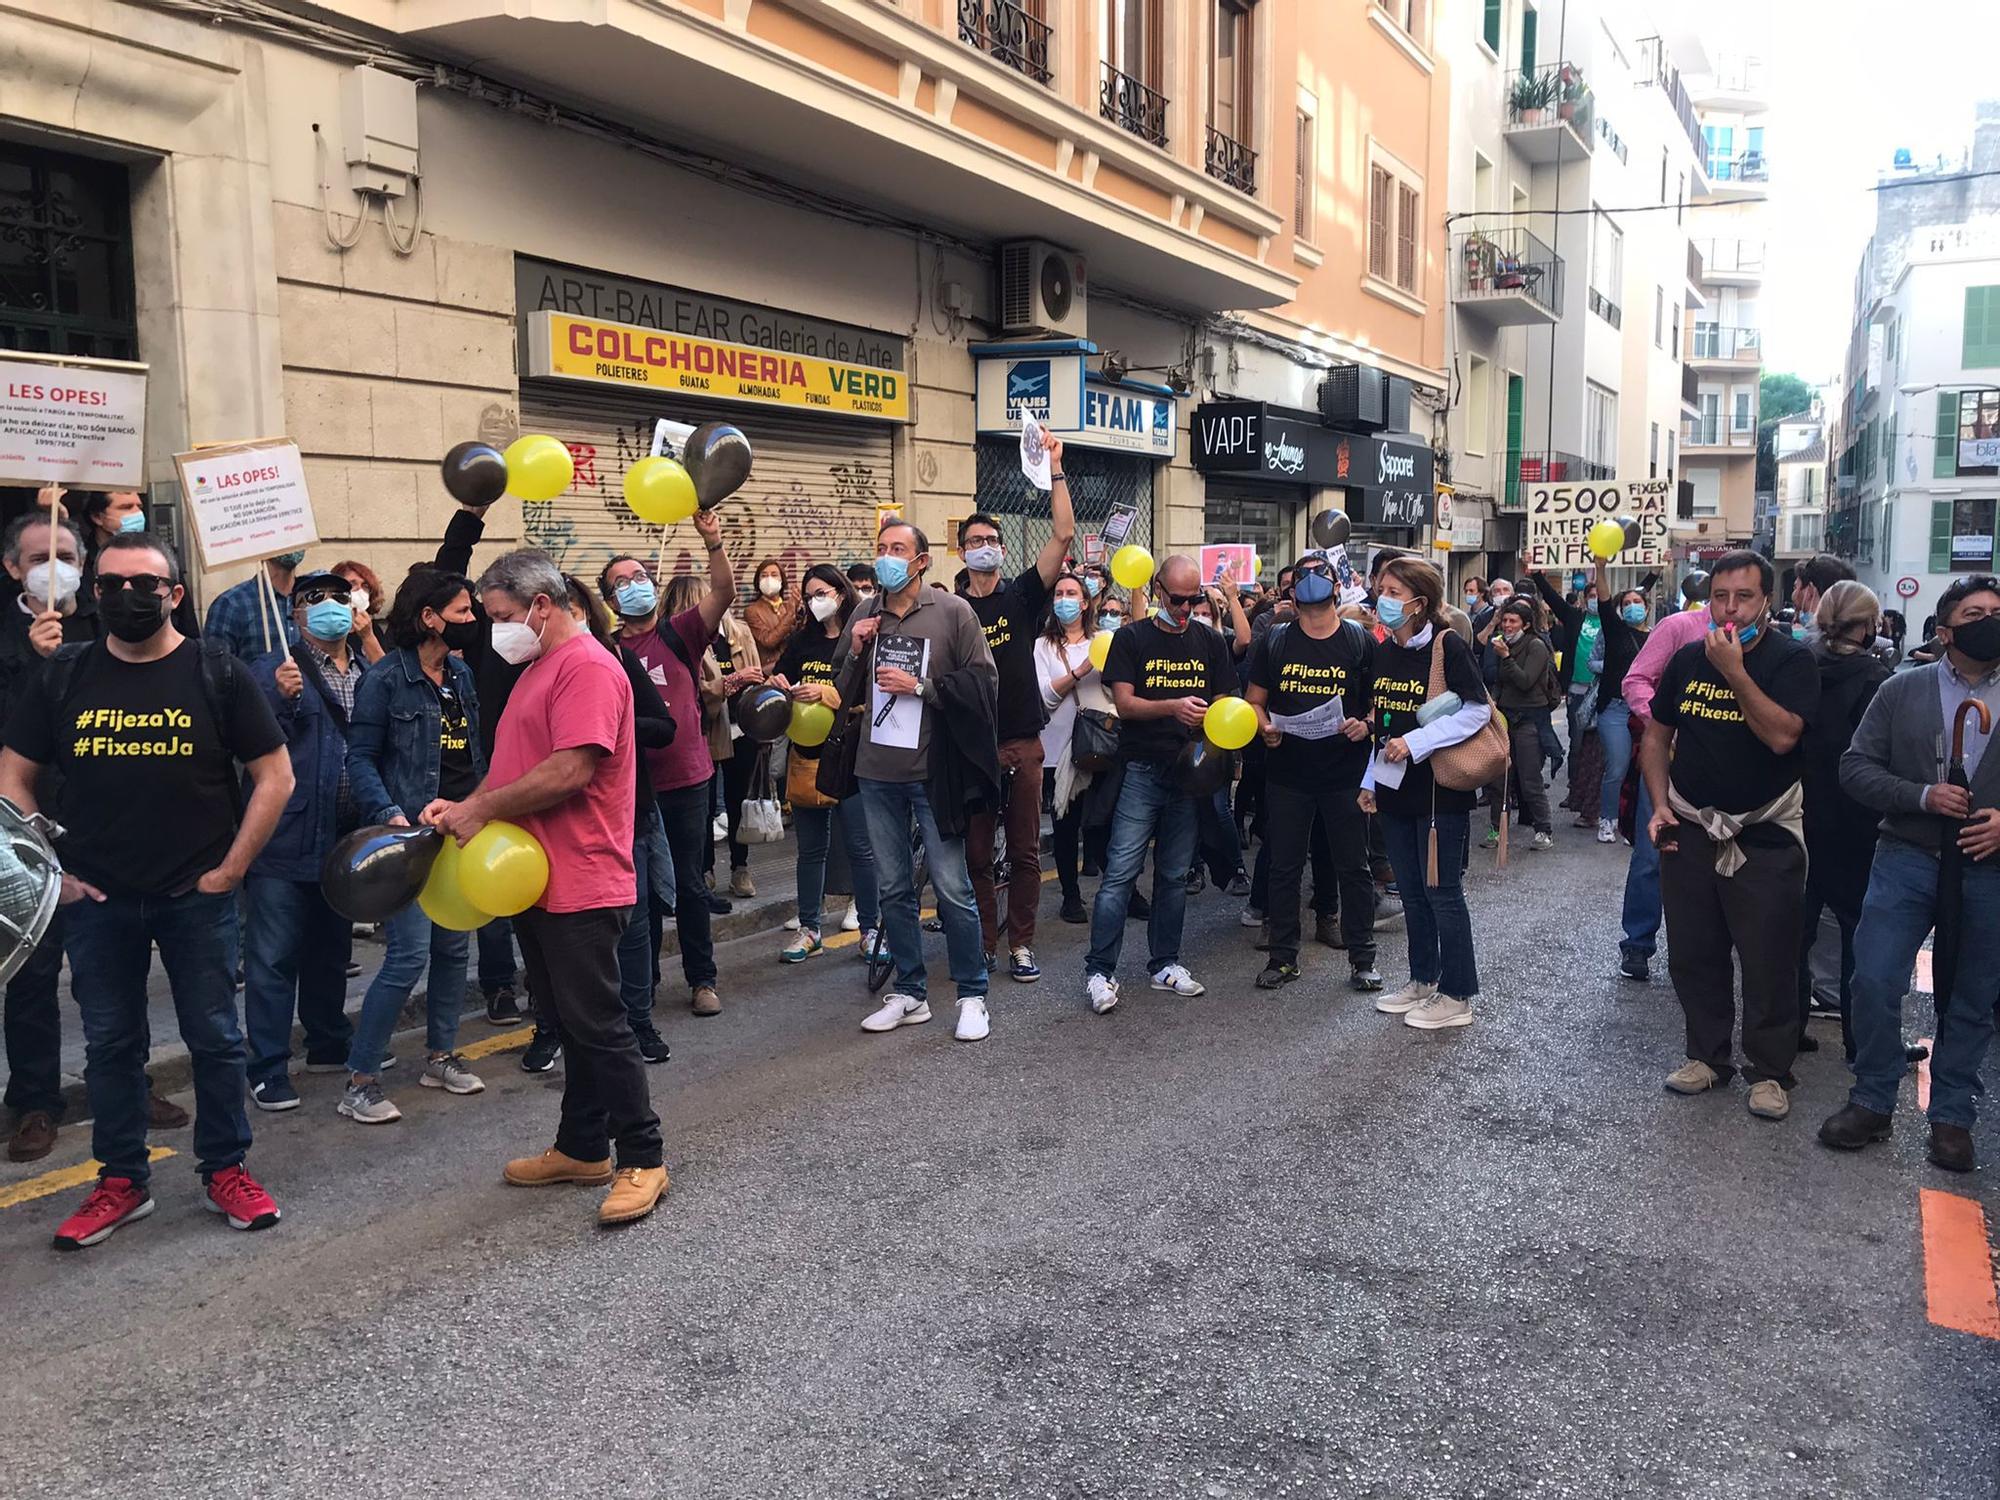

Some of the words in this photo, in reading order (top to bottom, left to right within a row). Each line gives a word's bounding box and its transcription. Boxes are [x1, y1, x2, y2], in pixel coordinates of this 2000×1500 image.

[538, 275, 732, 342] ART-BALEAR
[740, 314, 818, 357] Galeria
[826, 332, 849, 362] de
[855, 338, 892, 370] Arte
[569, 324, 807, 389] COLCHONERIA
[828, 367, 896, 401] VERD
[596, 363, 648, 382] POLIETERES
[679, 374, 710, 390] GUATAS
[9, 383, 44, 400] LES
[50, 387, 107, 406] OPES!
[738, 383, 781, 399] ALMOHADAS
[805, 392, 831, 405] FUNDAS
[852, 400, 882, 412] PLASTICOS
[1009, 396, 1048, 408] VIAJES
[1006, 409, 1050, 420] UEAM
[4, 426, 46, 437] APLICACIÓ
[48, 430, 58, 438] DE
[90, 425, 106, 433] SÓN
[1201, 415, 1257, 455] VAPE
[216, 473, 241, 489] LAS
[242, 466, 280, 484] OPES!
[1534, 488, 1621, 514] 2500
[1631, 495, 1666, 513] JA!
[1532, 545, 1560, 565] EN
[1145, 659, 1205, 674] #FijezaYa
[1281, 663, 1346, 679] #FijezaYa
[1145, 675, 1206, 688] #FixesaJa
[1279, 680, 1346, 696] #FixesaJa
[1373, 677, 1425, 695] #FijezaYa
[75, 708, 192, 732] #FijezaYa
[73, 736, 194, 757] #FixesaJa
